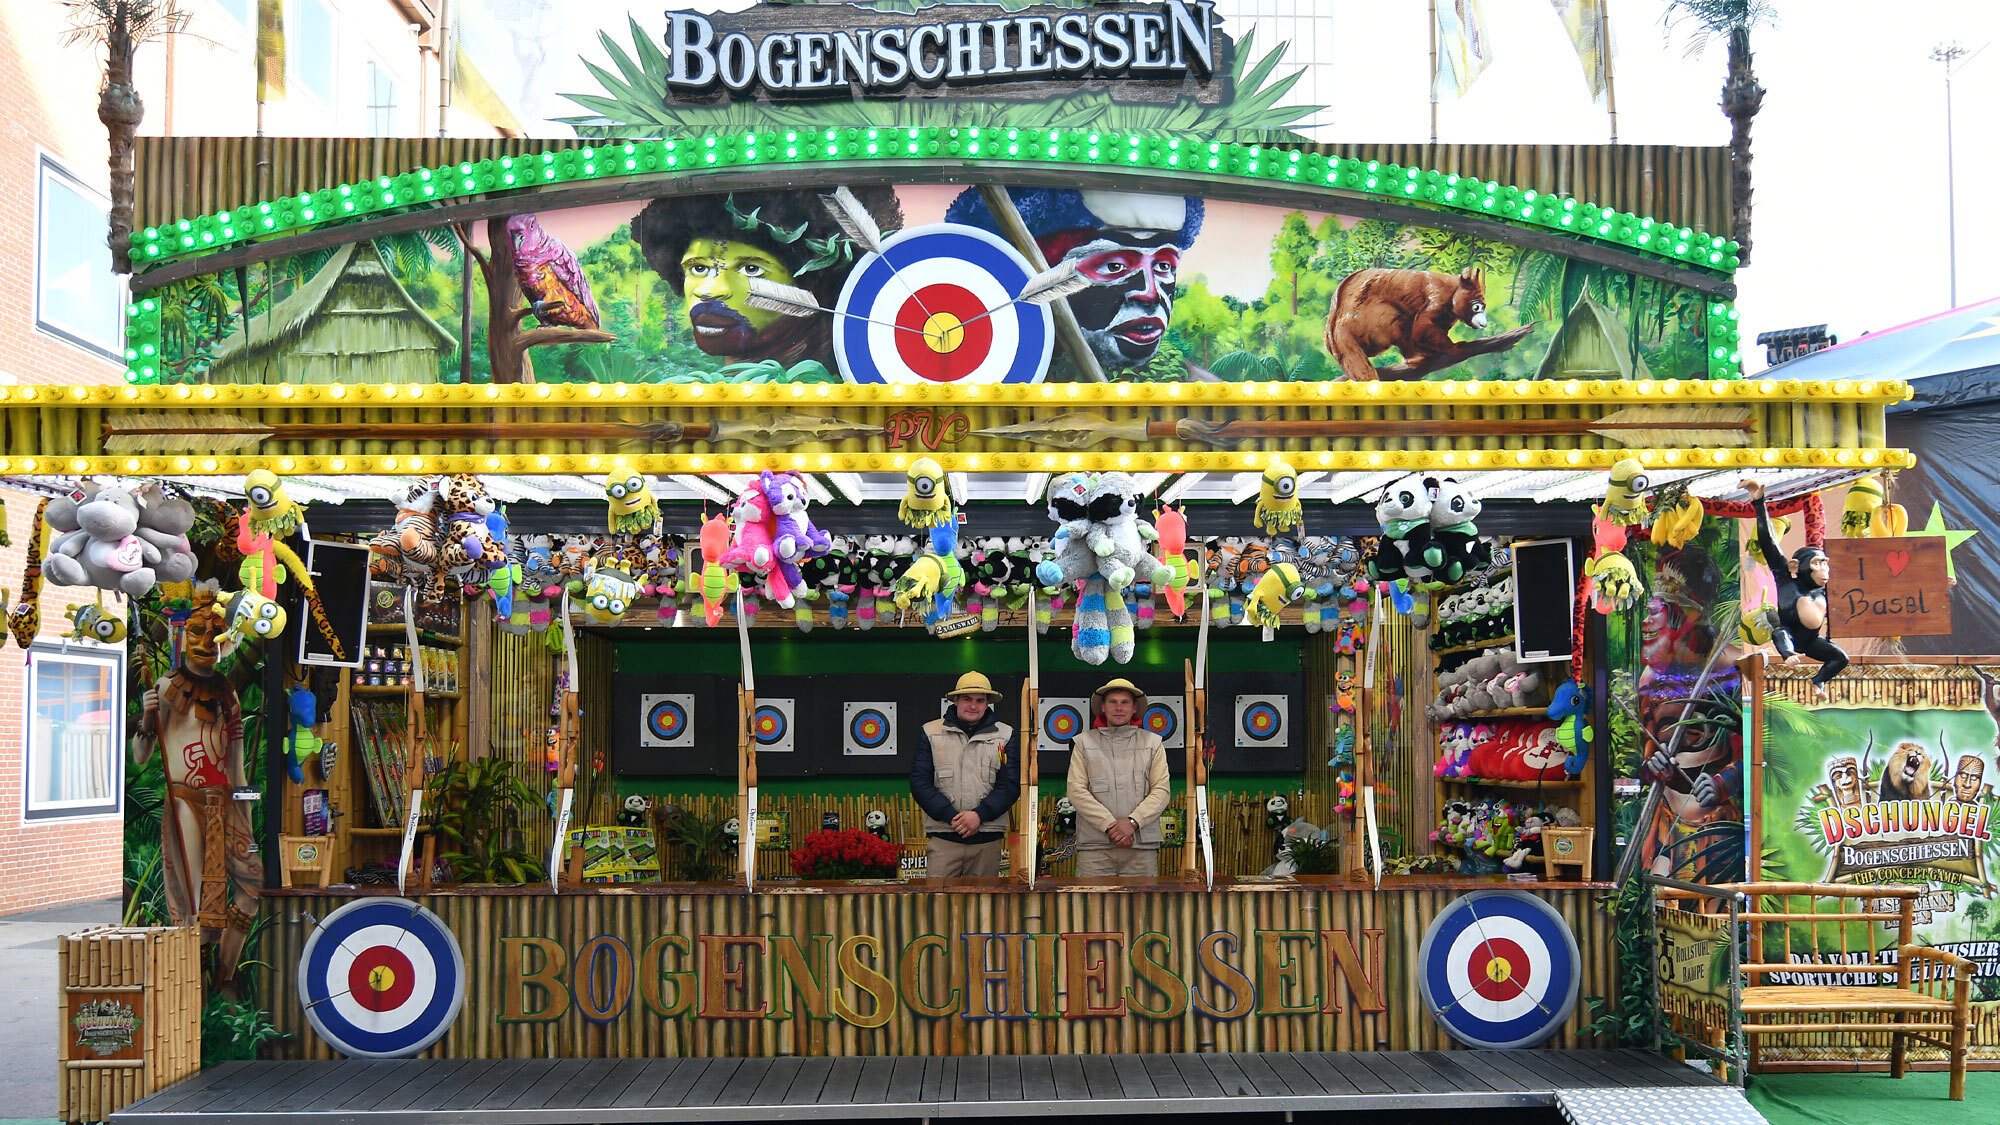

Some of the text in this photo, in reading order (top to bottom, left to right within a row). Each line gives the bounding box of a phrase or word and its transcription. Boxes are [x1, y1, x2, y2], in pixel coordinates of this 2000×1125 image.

[667, 0, 1213, 89] BOGENSCHIESSEN
[1858, 557, 1865, 581] I
[1842, 588, 1930, 624] Basel
[1819, 801, 1990, 845] DSCHUNGEL
[1843, 838, 1970, 866] BOGENSCHIESSEN
[1853, 867, 1964, 886] THE CONCEPT GAME!
[1676, 940, 1710, 963] ROLLSTUHL
[497, 929, 1387, 1029] BOGENSCHIESSEN
[1682, 964, 1705, 984] RAMPE
[1770, 971, 1877, 986] SPORTLICHE
